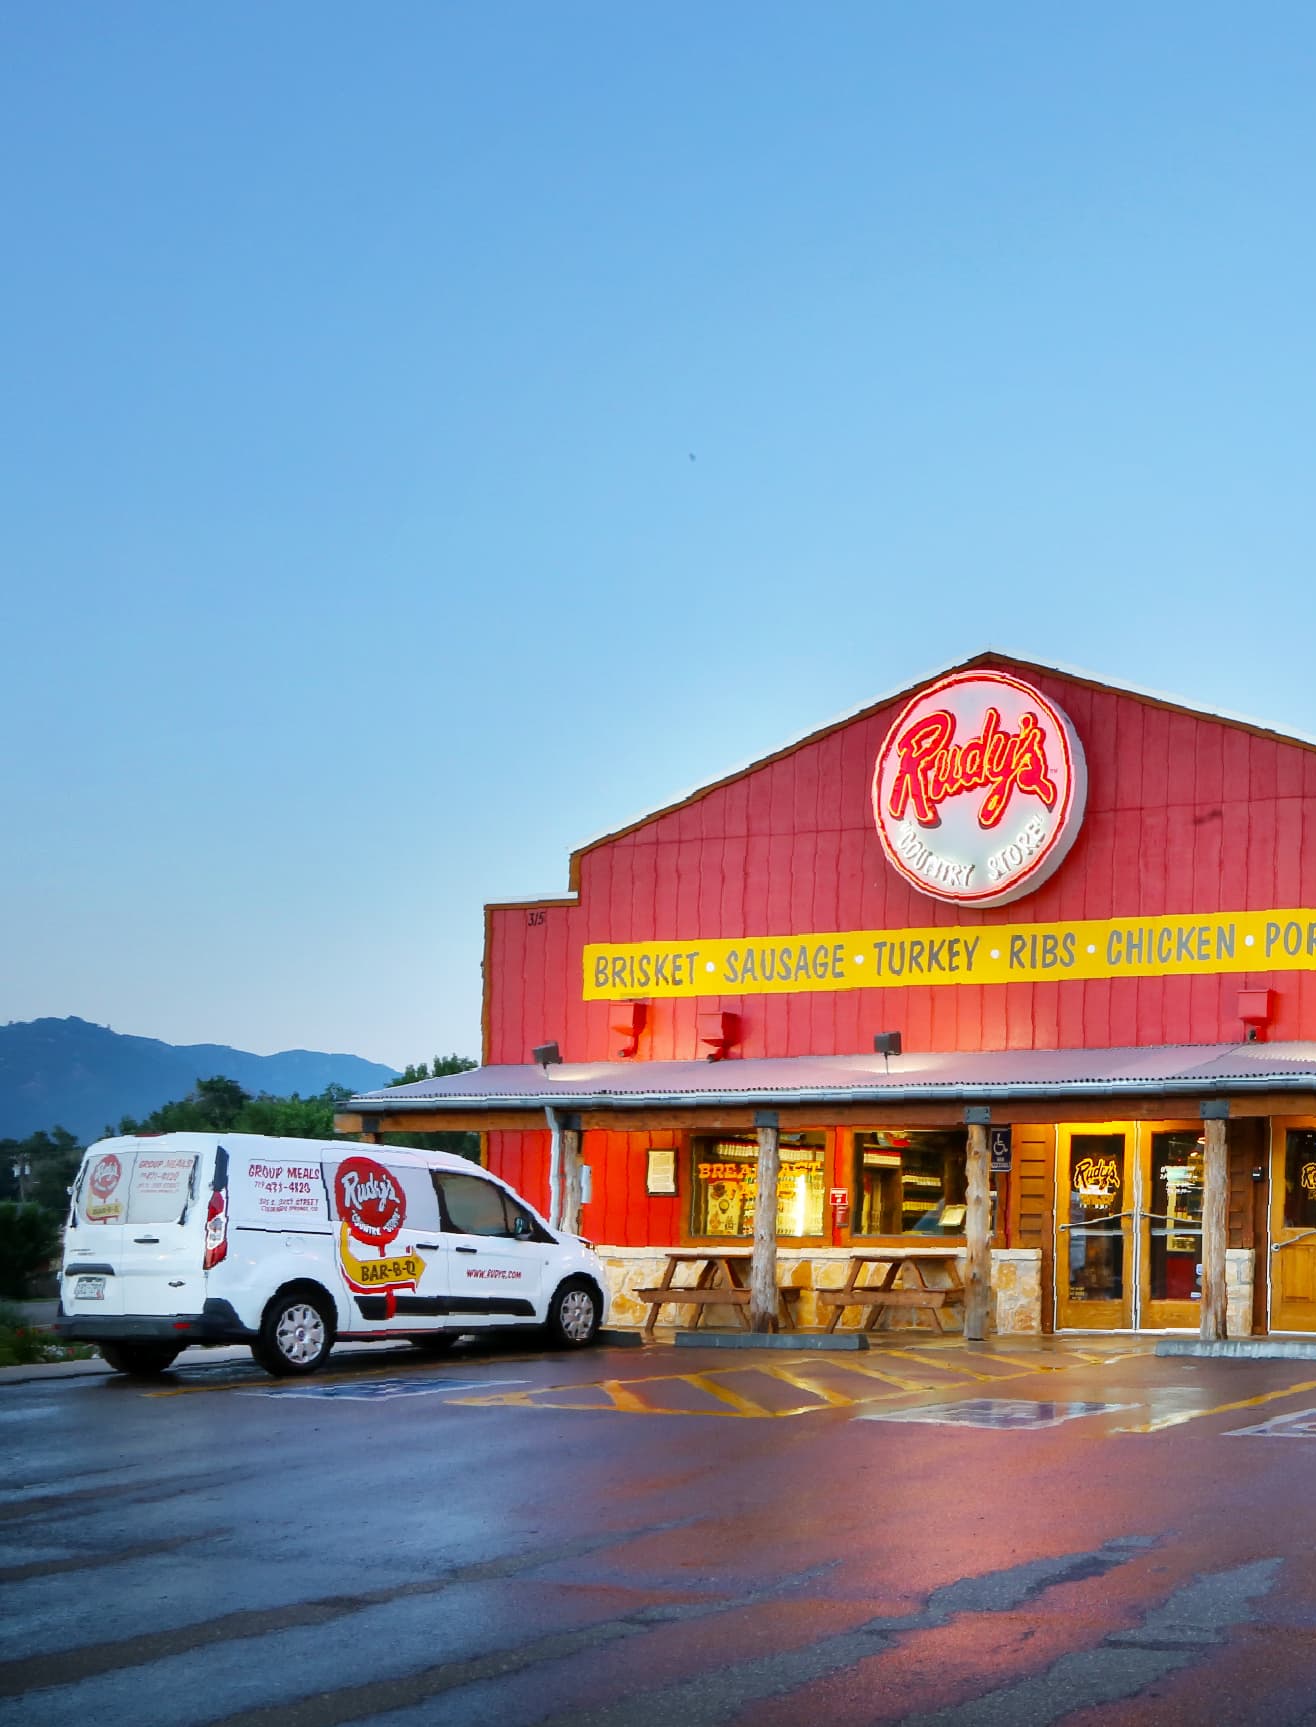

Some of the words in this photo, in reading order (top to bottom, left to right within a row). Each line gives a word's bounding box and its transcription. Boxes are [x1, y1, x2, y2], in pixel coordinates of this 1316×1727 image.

[888, 708, 1057, 828] Rudy's
[594, 951, 700, 988] BRISKET
[723, 944, 846, 985] SAUSAGE
[873, 936, 980, 976] TURKEY
[1009, 932, 1077, 969] RIBS
[1106, 923, 1236, 965] CHICKEN
[248, 1164, 283, 1179] GROUP
[287, 1167, 320, 1180] MEALS
[698, 1160, 824, 1180] BREAAST
[1074, 1157, 1120, 1191] Rudy's
[341, 1171, 401, 1213] Rudy's
[361, 1261, 417, 1281] BAR-B-Q
